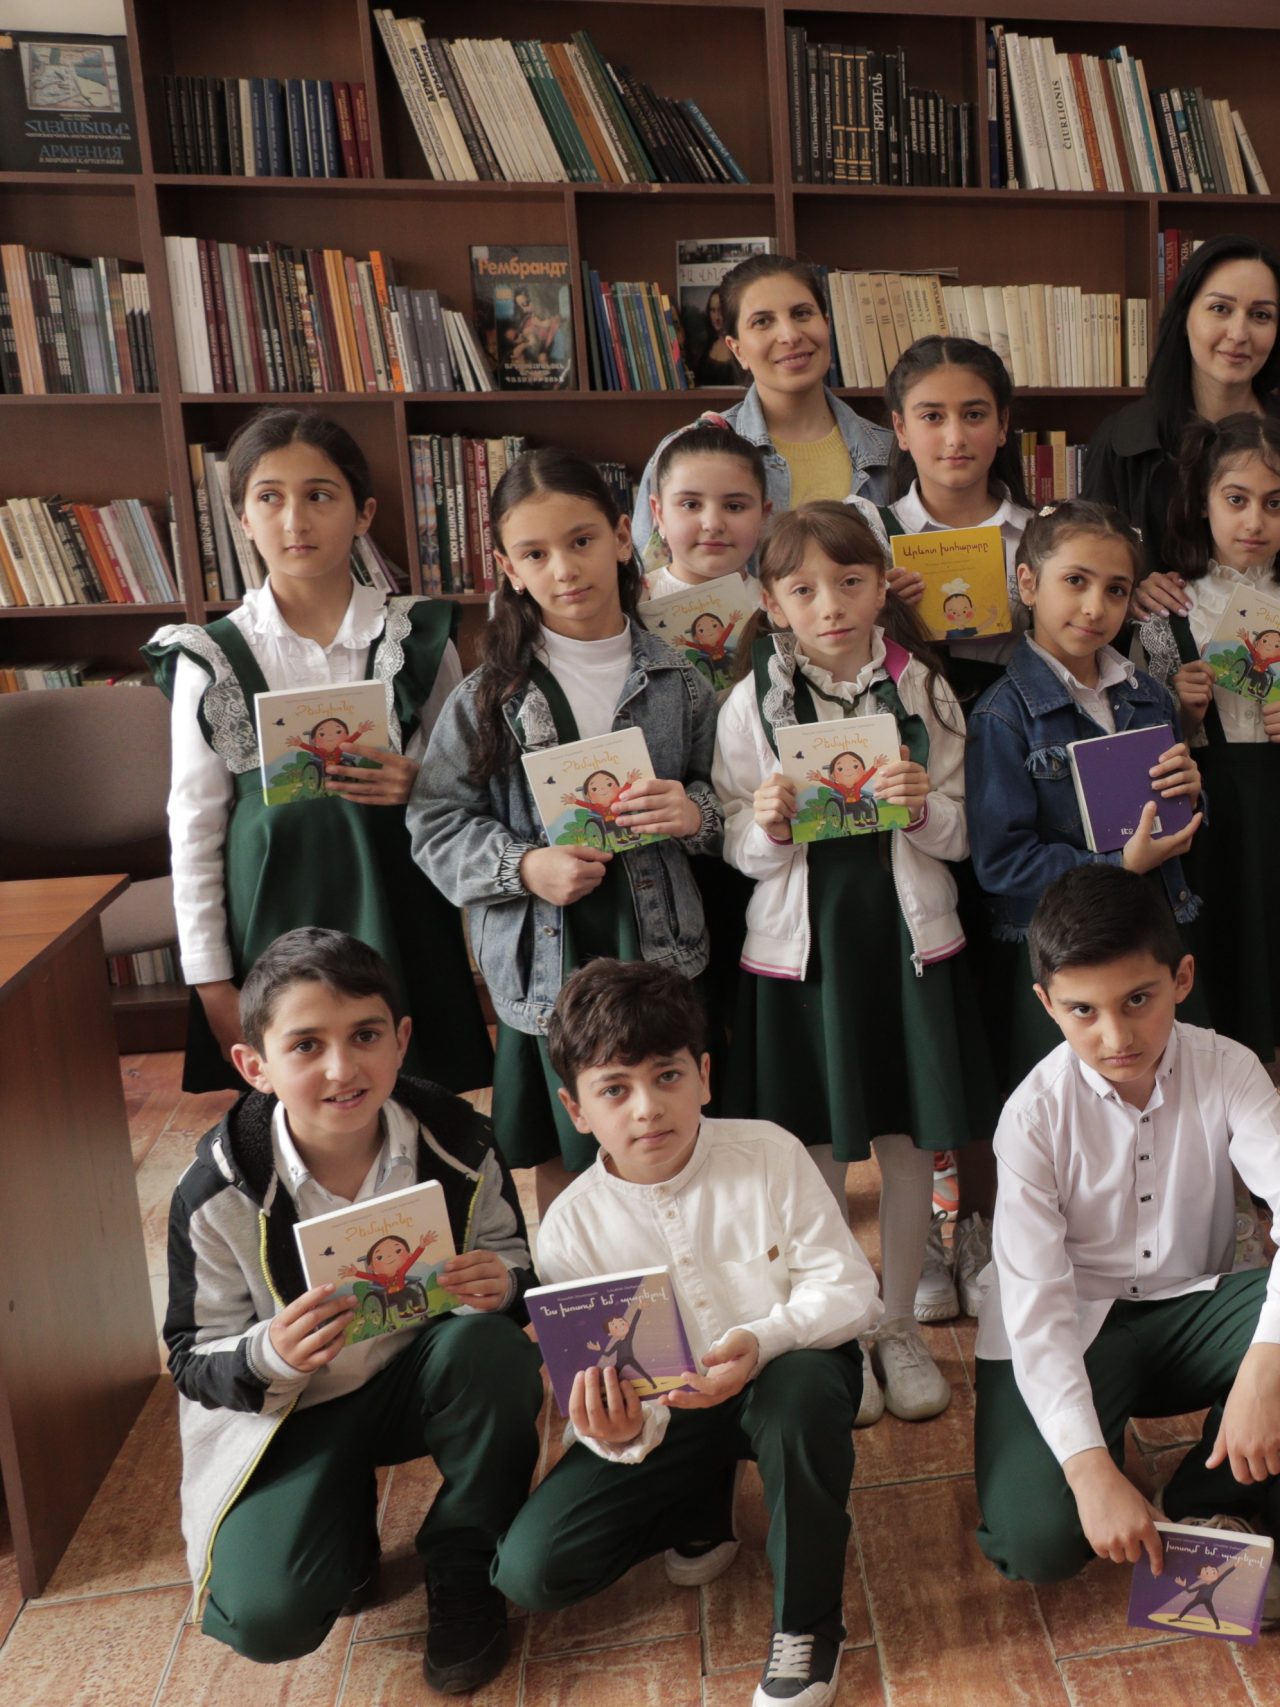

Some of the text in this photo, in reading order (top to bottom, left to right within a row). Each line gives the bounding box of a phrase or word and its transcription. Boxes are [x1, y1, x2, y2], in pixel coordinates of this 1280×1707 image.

[869, 73, 885, 131] БРЕЙГЕЛЬ
[1052, 80, 1072, 149] ČIURLIONIS
[40, 144, 123, 158] АРМЕНИЯ
